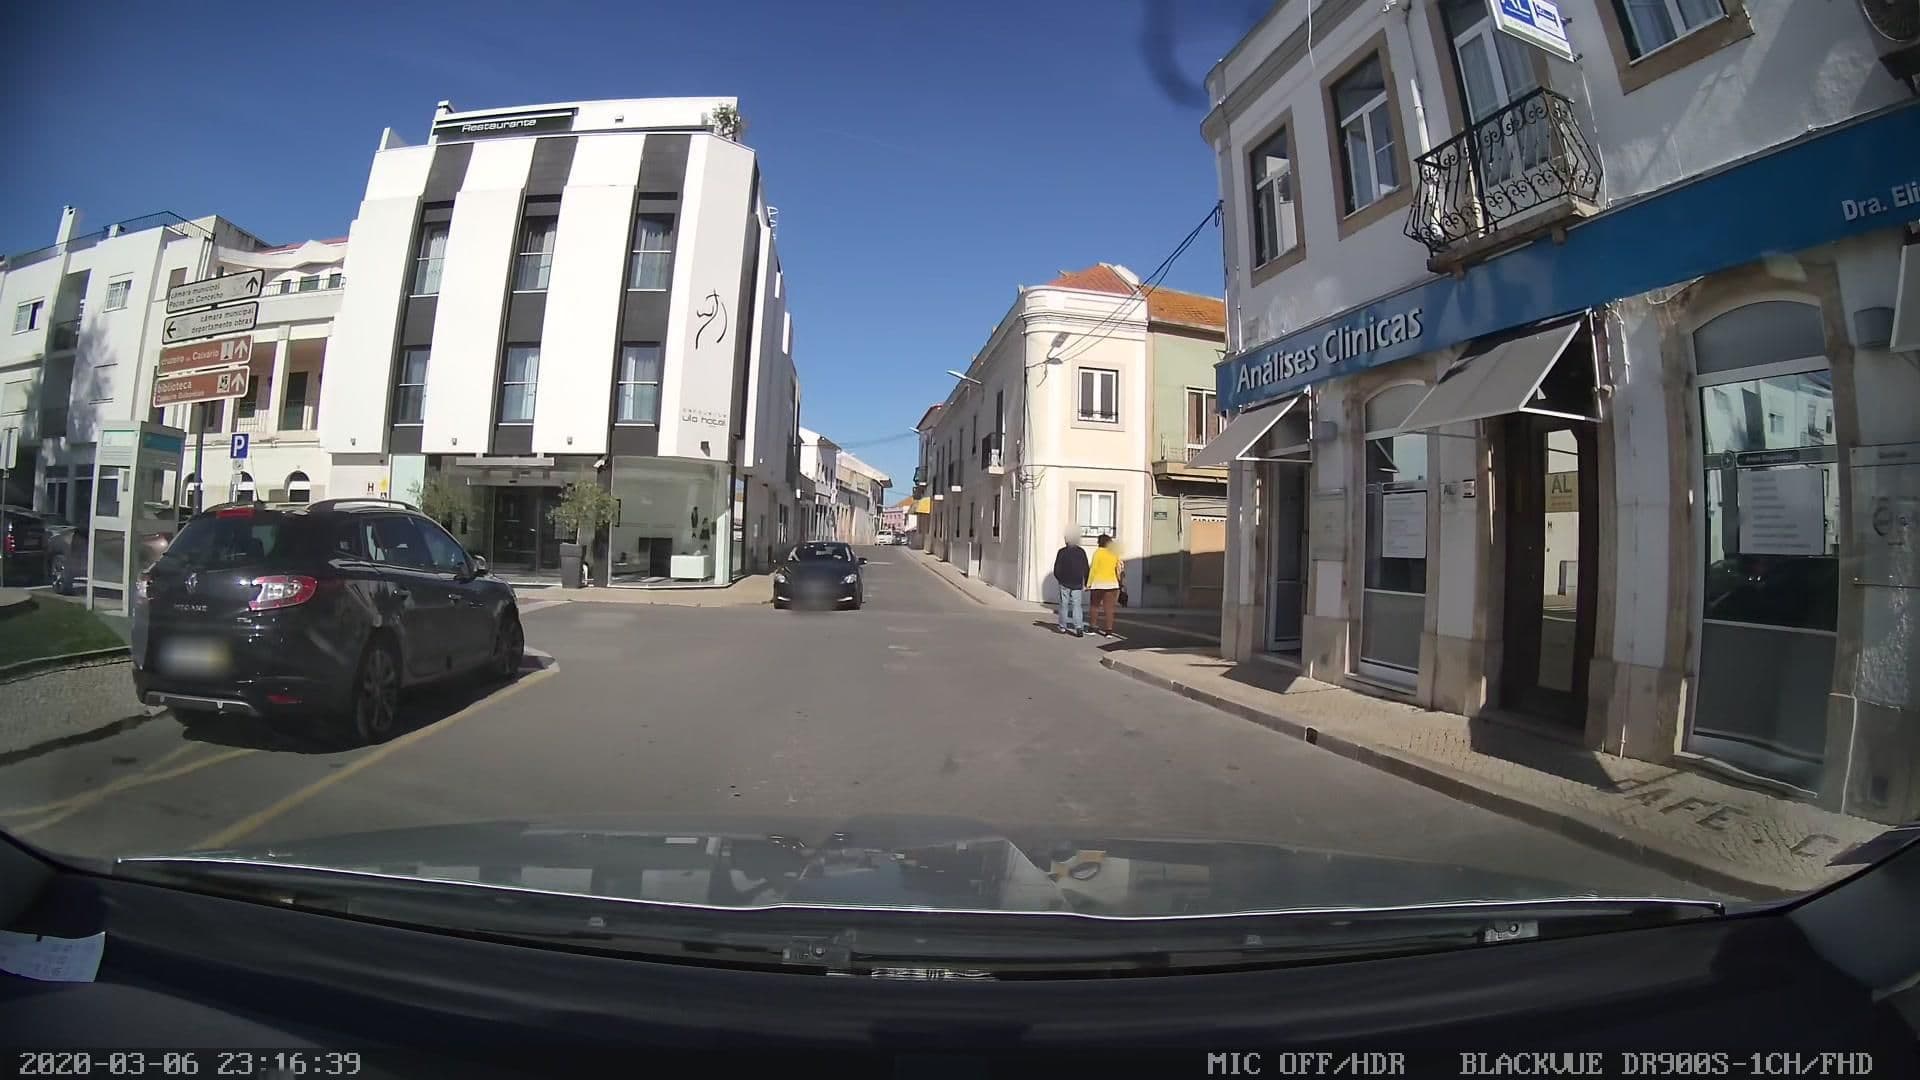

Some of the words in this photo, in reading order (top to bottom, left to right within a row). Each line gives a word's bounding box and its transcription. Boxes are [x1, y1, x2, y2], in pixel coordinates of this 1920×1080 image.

[461, 118, 537, 133] Restaurante
[1841, 197, 1888, 221] Dra.
[1891, 181, 1920, 208] Eli
[1236, 346, 1318, 393] Análises
[233, 436, 245, 457] P
[1551, 475, 1572, 494] AL
